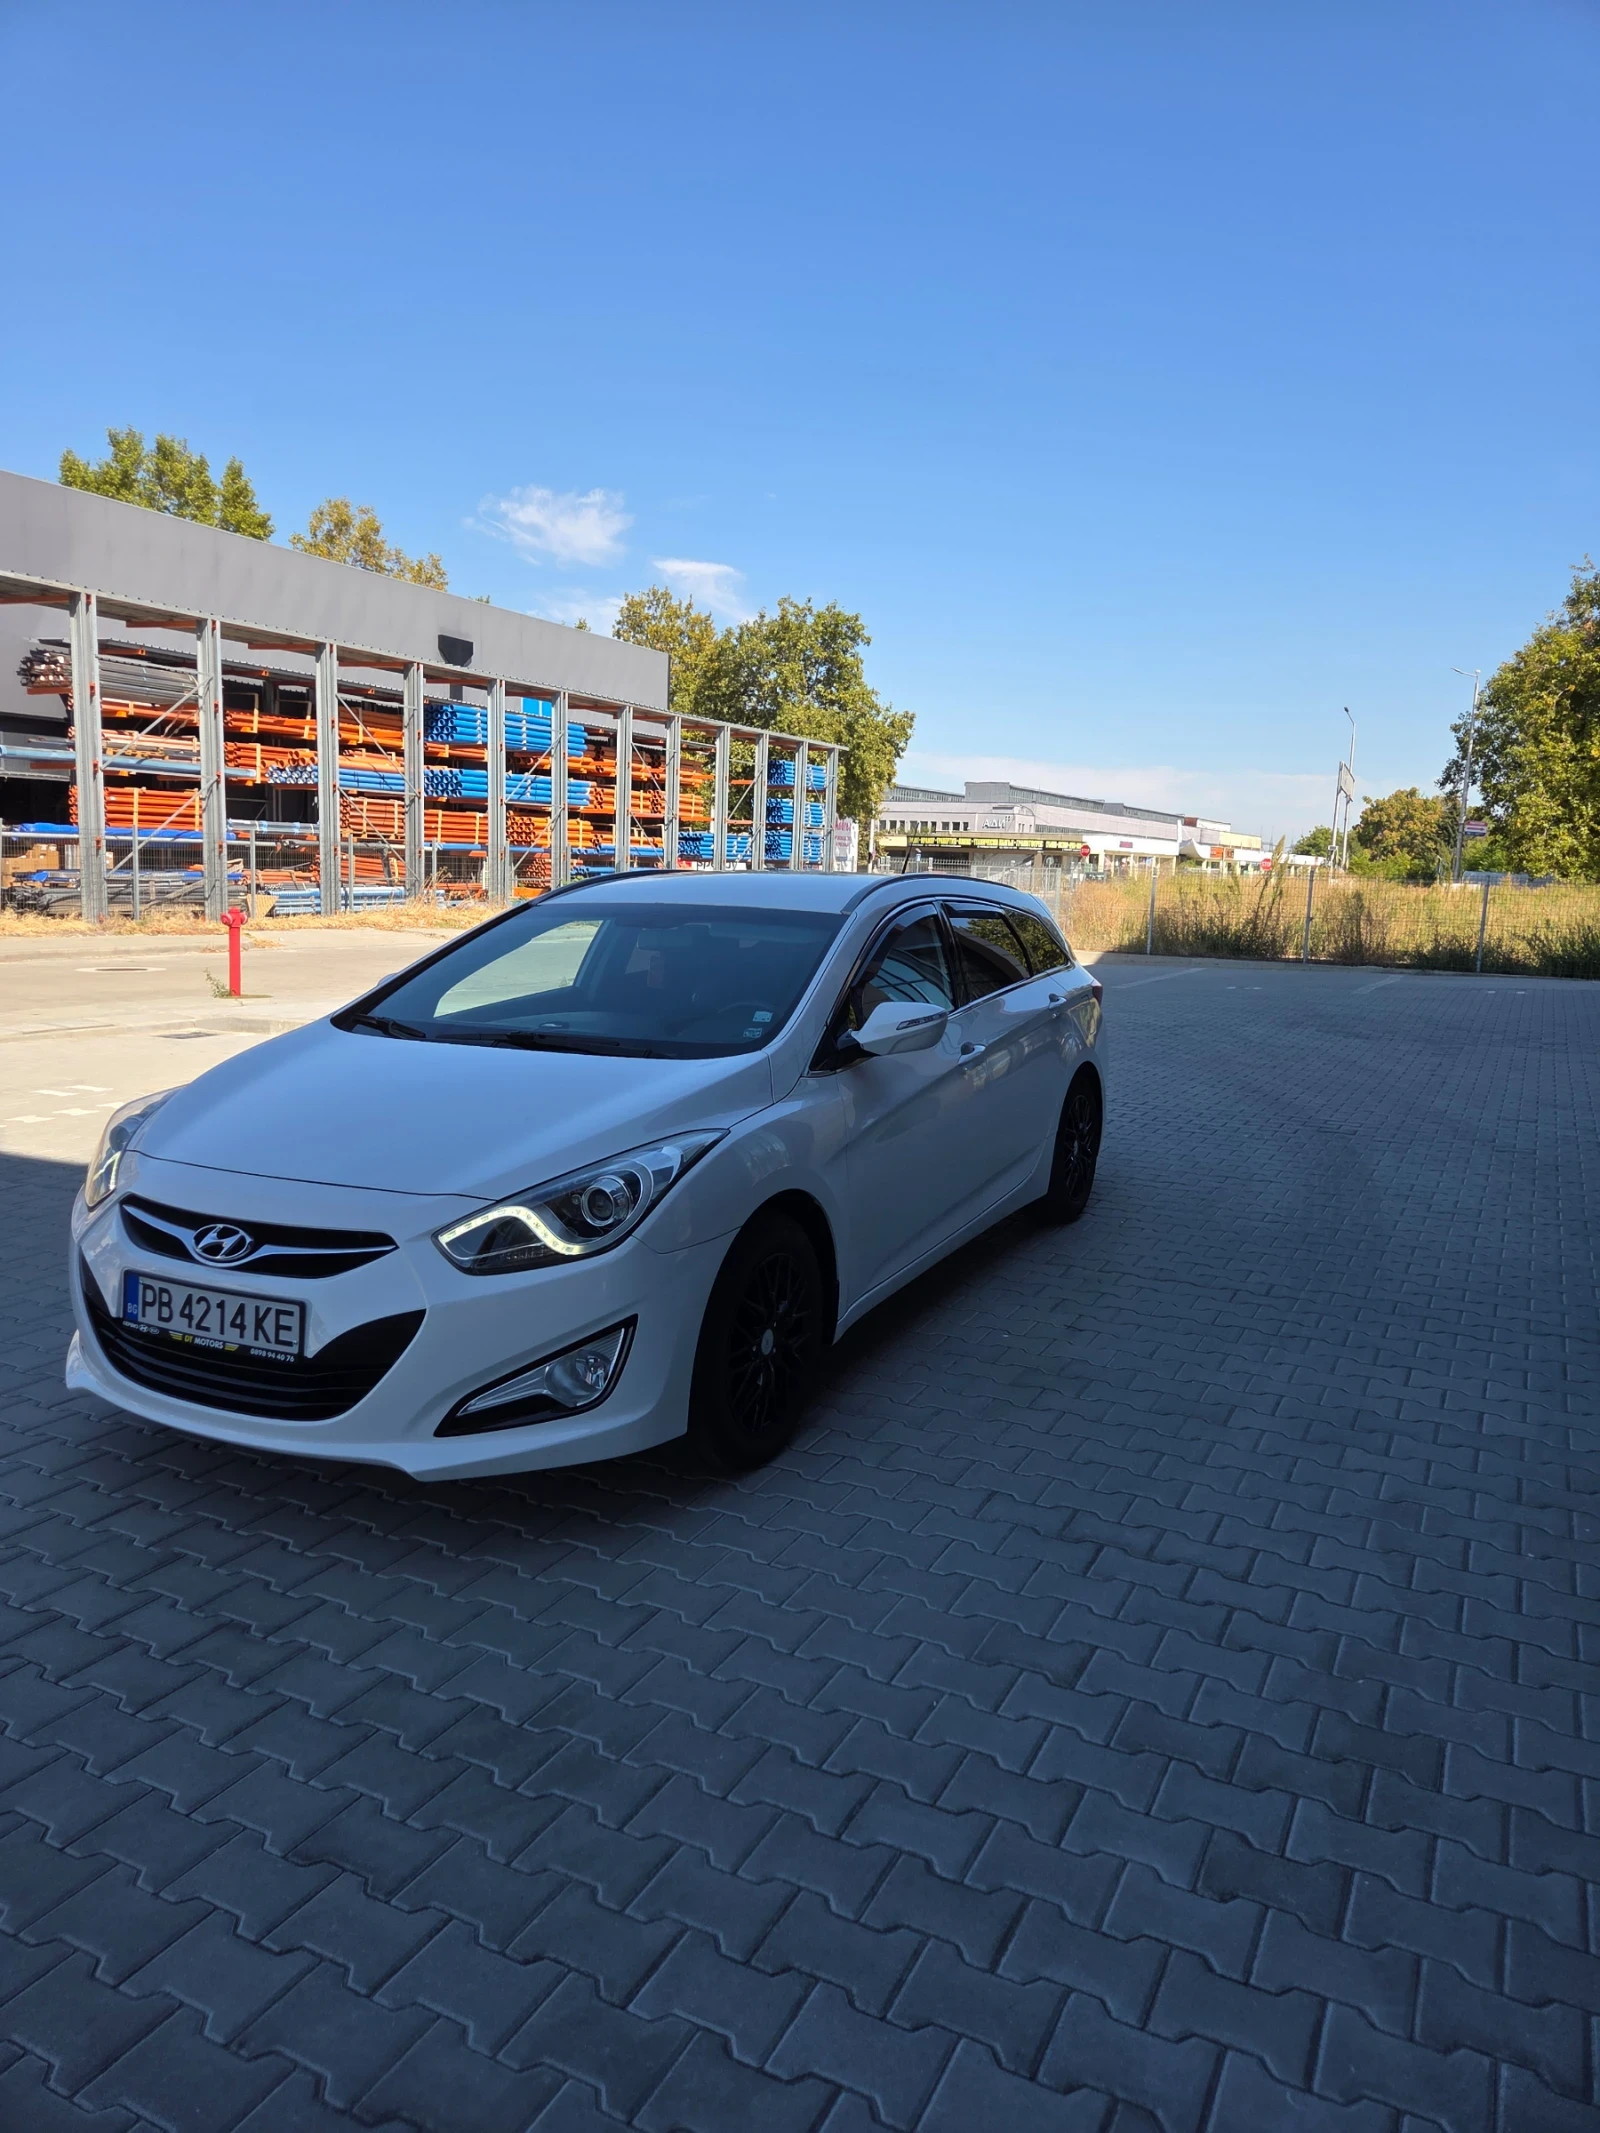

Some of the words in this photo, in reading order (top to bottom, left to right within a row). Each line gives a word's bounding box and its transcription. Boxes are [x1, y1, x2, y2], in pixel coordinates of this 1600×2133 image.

[127, 1302, 138, 1314] BG
[141, 1283, 173, 1323] PB
[179, 1293, 247, 1339] 4214
[253, 1304, 295, 1347] KE
[184, 1335, 193, 1343] DT
[194, 1337, 224, 1349] MOTORS
